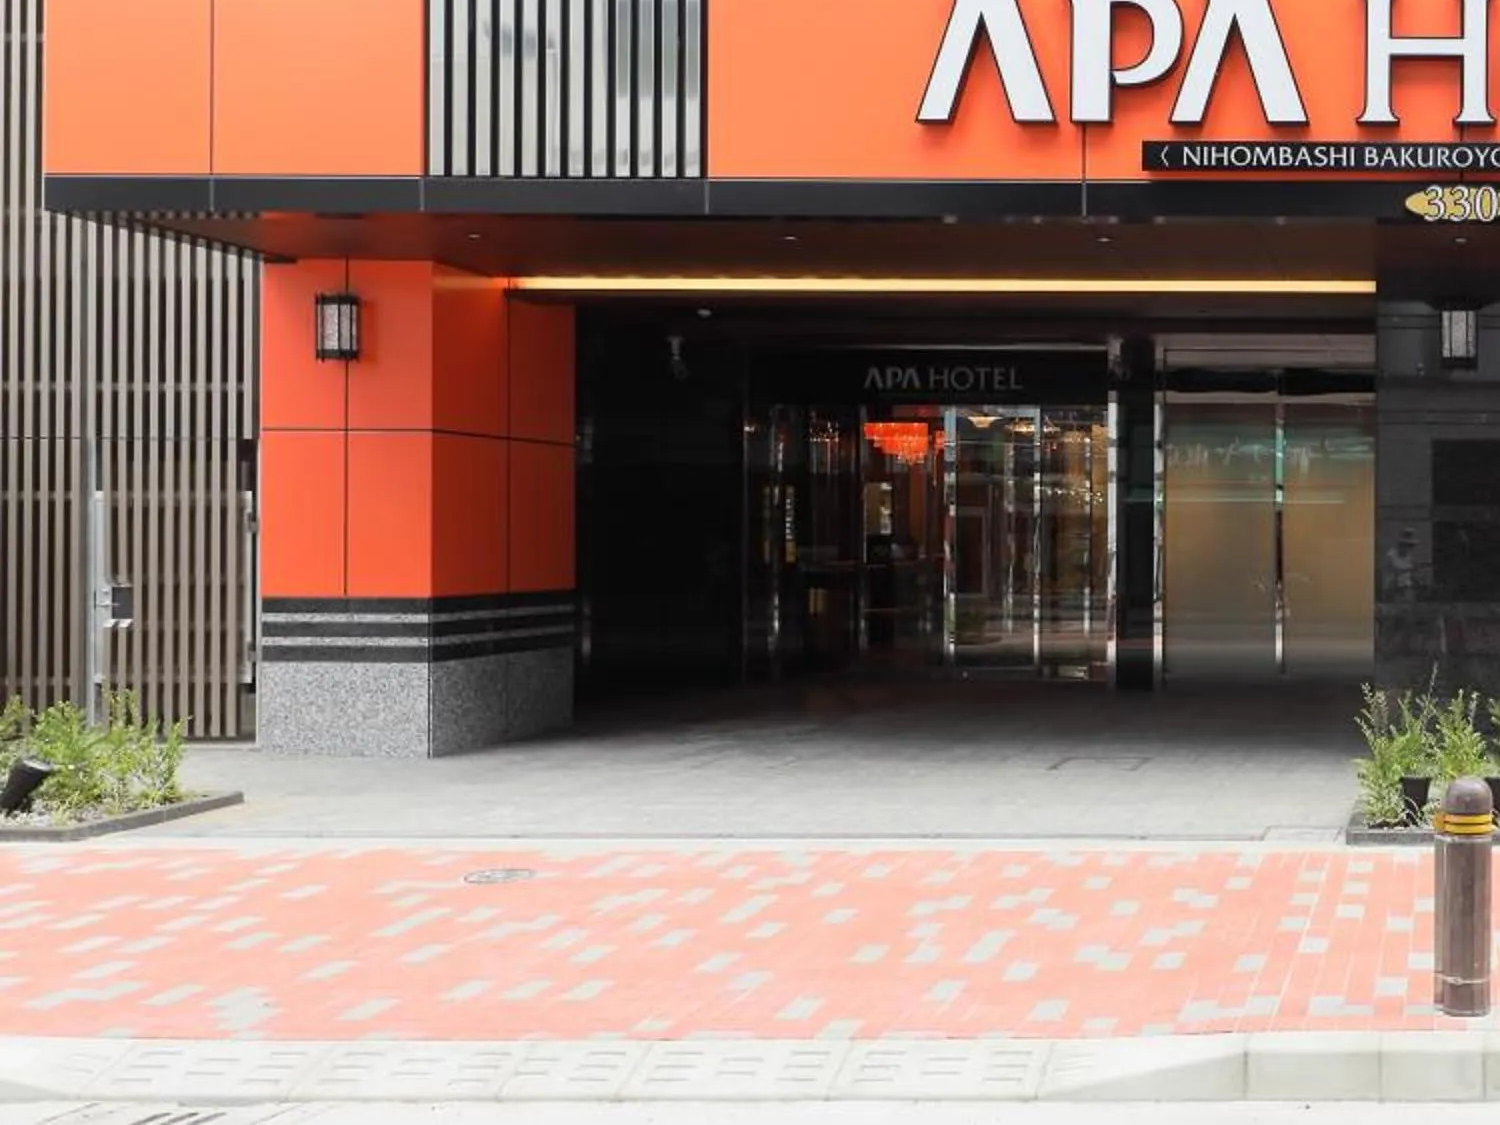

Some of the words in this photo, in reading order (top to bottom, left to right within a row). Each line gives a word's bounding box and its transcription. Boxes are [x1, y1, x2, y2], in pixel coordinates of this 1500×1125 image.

[1183, 146, 1355, 166] NIHOMBASHI
[1422, 184, 1500, 222] 330
[863, 367, 921, 389] APA
[928, 366, 1024, 390] HOTEL
